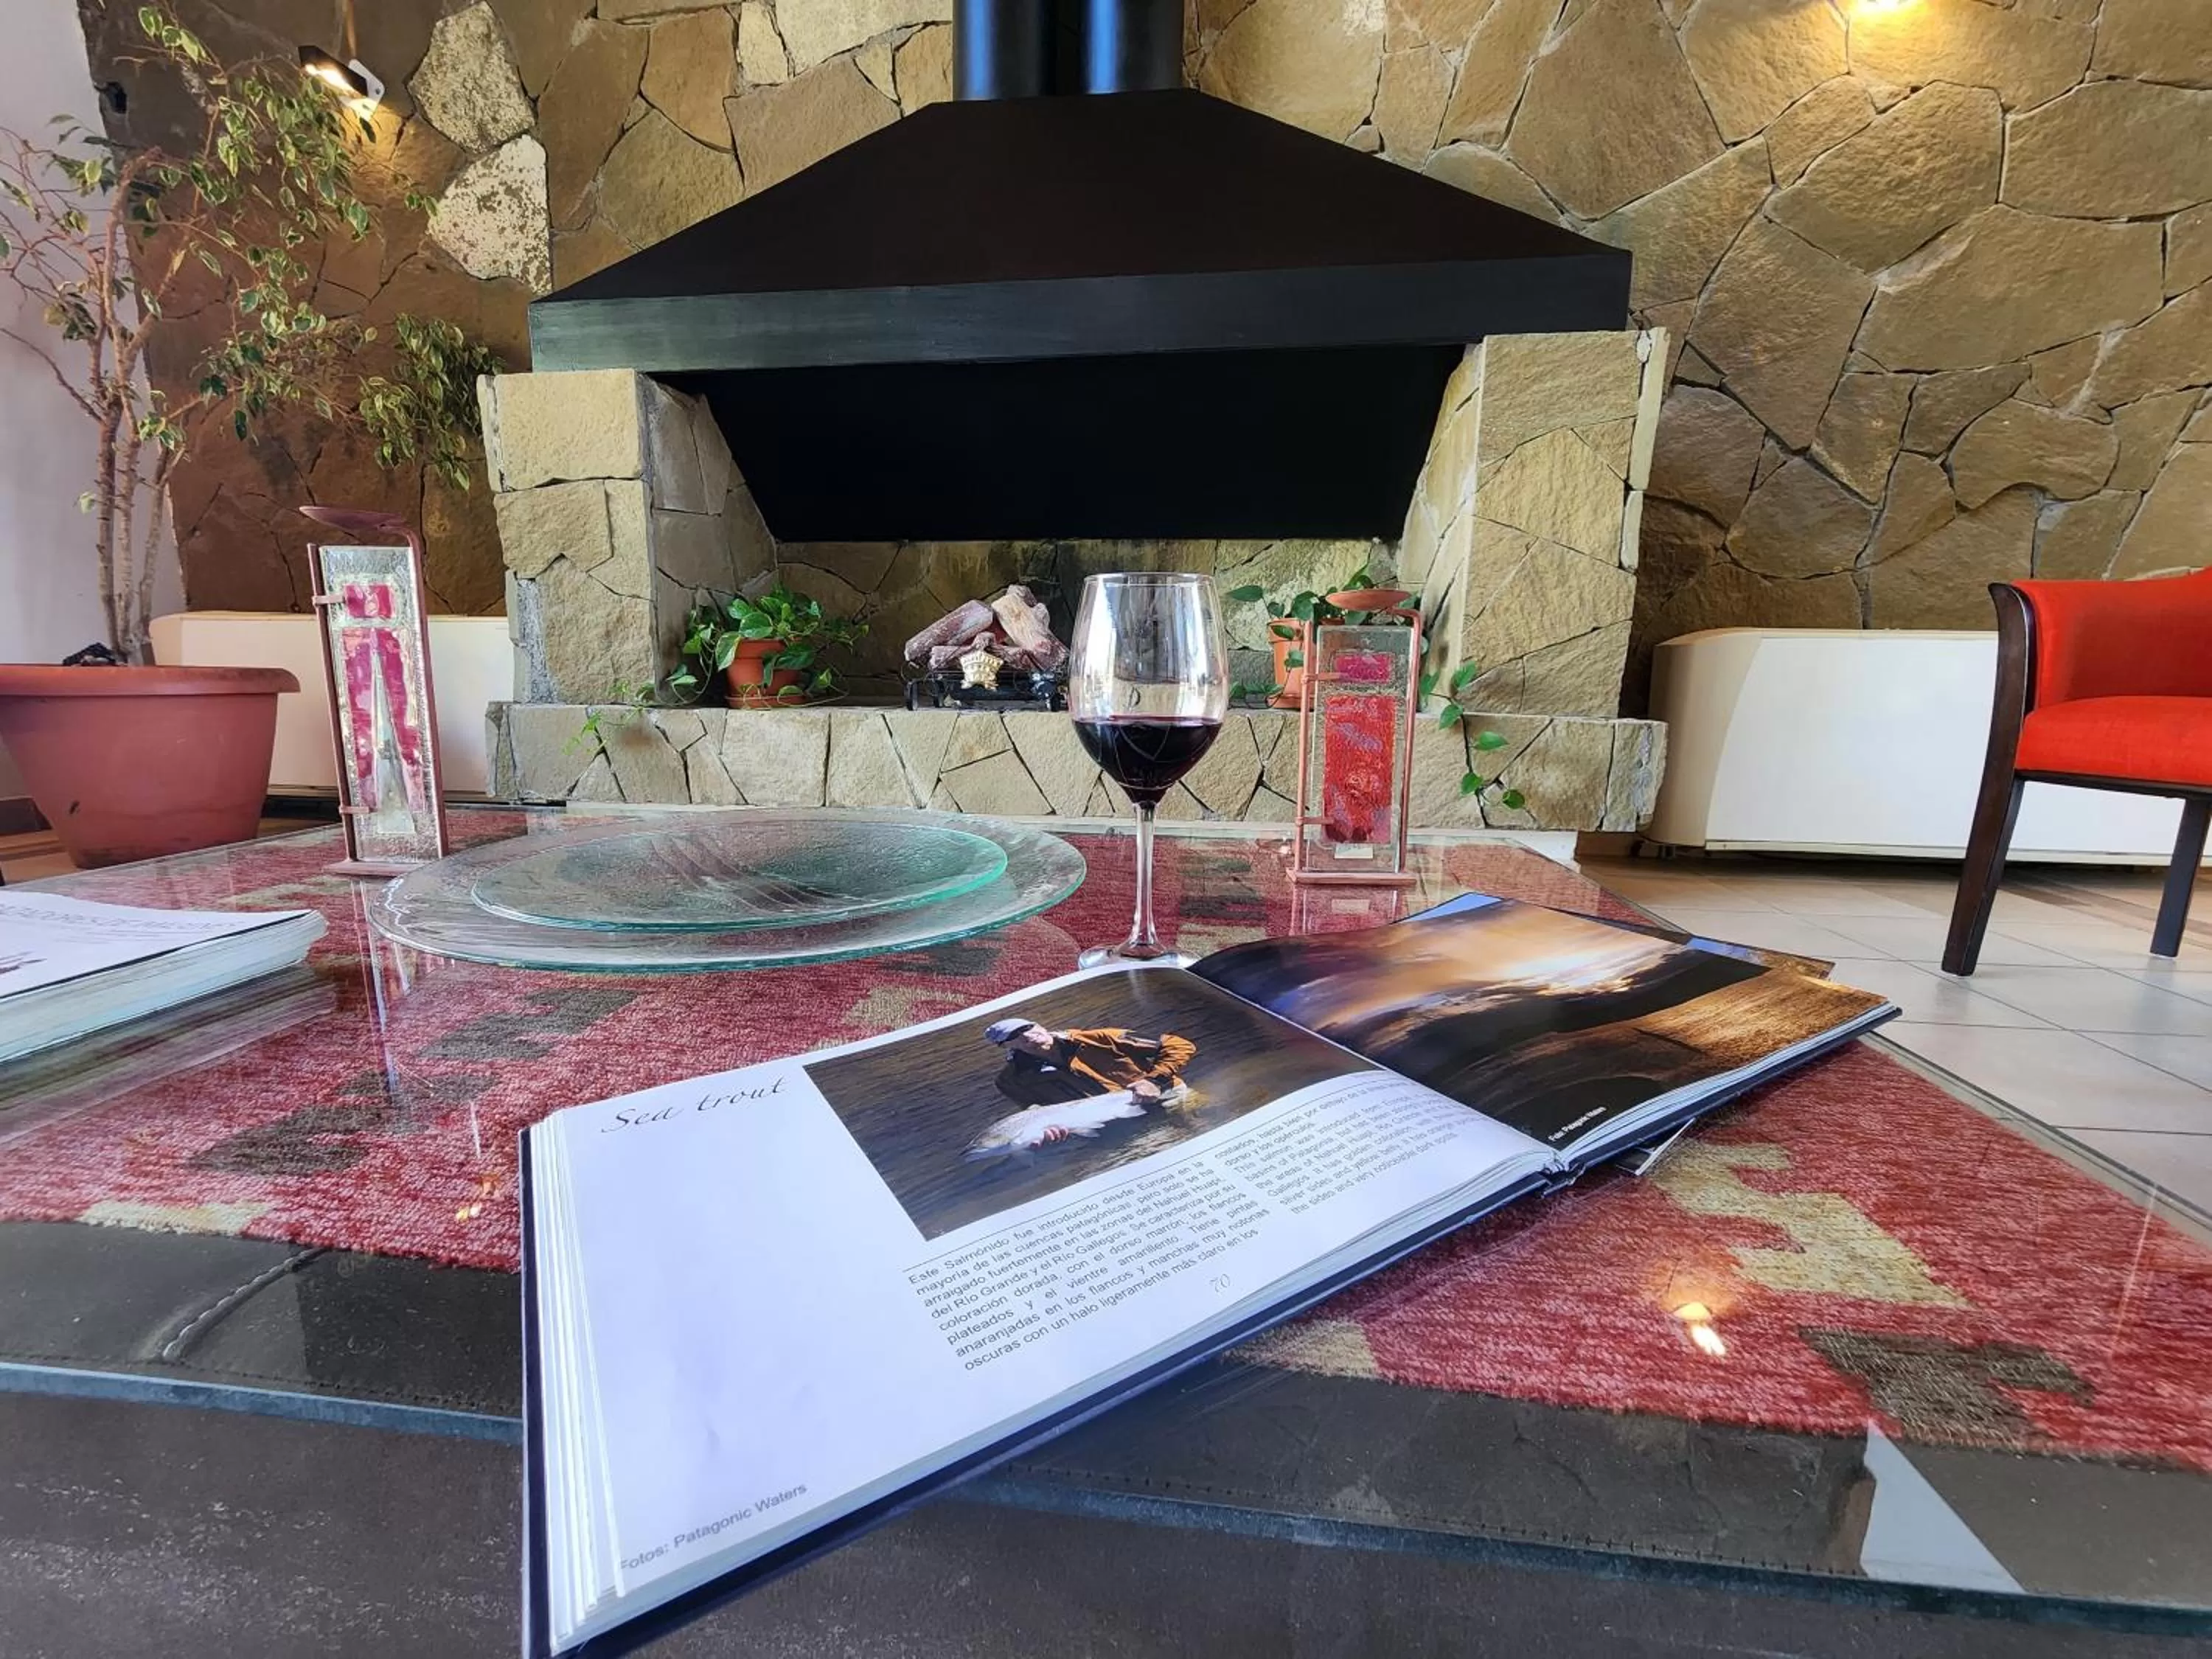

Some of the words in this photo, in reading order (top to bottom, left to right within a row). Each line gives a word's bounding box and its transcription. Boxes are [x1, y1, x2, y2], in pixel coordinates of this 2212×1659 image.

[601, 1107, 684, 1133] Sea
[697, 1075, 786, 1111] trout
[908, 1268, 939, 1284] Este
[943, 1239, 1010, 1269] Salmónido
[1013, 1230, 1034, 1240] fue
[1037, 1203, 1099, 1231] introducido
[1102, 1189, 1136, 1205] desde
[1136, 1173, 1176, 1191] Europa
[931, 1303, 953, 1319] del
[979, 1272, 1029, 1296] Grande
[1029, 1267, 1037, 1276] y
[1040, 1260, 1051, 1270] el
[1130, 1222, 1147, 1231] Se
[1203, 1189, 1221, 1202] por
[939, 1295, 1008, 1331] coloración
[1014, 1273, 1062, 1297] dorada,
[1067, 1260, 1091, 1274] con
[1094, 1252, 1105, 1261] el
[1109, 1237, 1142, 1255] dorso
[1189, 1211, 1207, 1220] los
[1208, 1192, 1247, 1211] flancos
[946, 1310, 1014, 1346] plateados
[1025, 1301, 1032, 1310] y
[1046, 1288, 1057, 1298] el
[1065, 1267, 1108, 1289] vientre
[1188, 1218, 1220, 1234] Tiene
[1226, 1200, 1258, 1220] pintas
[955, 1313, 1040, 1357] anaranjadas
[1045, 1303, 1063, 1316] en
[1064, 1293, 1086, 1307] los
[1088, 1272, 1133, 1295] flancos
[1137, 1265, 1144, 1274] y
[1147, 1241, 1200, 1269] manchas
[1201, 1229, 1227, 1244] muy
[1228, 1208, 1270, 1231] notorias
[973, 1261, 990, 1271] de
[991, 1252, 1012, 1262] las
[1014, 1231, 1064, 1253] cuencas
[1136, 1191, 1162, 1205] pero
[987, 1244, 1062, 1279] fuertemente
[1065, 1237, 1079, 1246] en
[1079, 1228, 1099, 1239] las
[1100, 1213, 1135, 1232] zonas
[1136, 1205, 1153, 1215] del
[1152, 1189, 1192, 1210] Nahuel
[1209, 1273, 1231, 1293] 70
[964, 1340, 1021, 1371] oscuras
[1023, 1326, 1049, 1343] con
[1050, 1318, 1070, 1330] un
[1068, 1304, 1099, 1321] halo
[1098, 1270, 1170, 1307] ligeramente
[1170, 1259, 1197, 1273] más
[1197, 1245, 1226, 1262] claro
[1227, 1237, 1241, 1246] en
[1239, 1230, 1258, 1239] los
[673, 1506, 752, 1548] Patagonic
[754, 1484, 808, 1512] Waters
